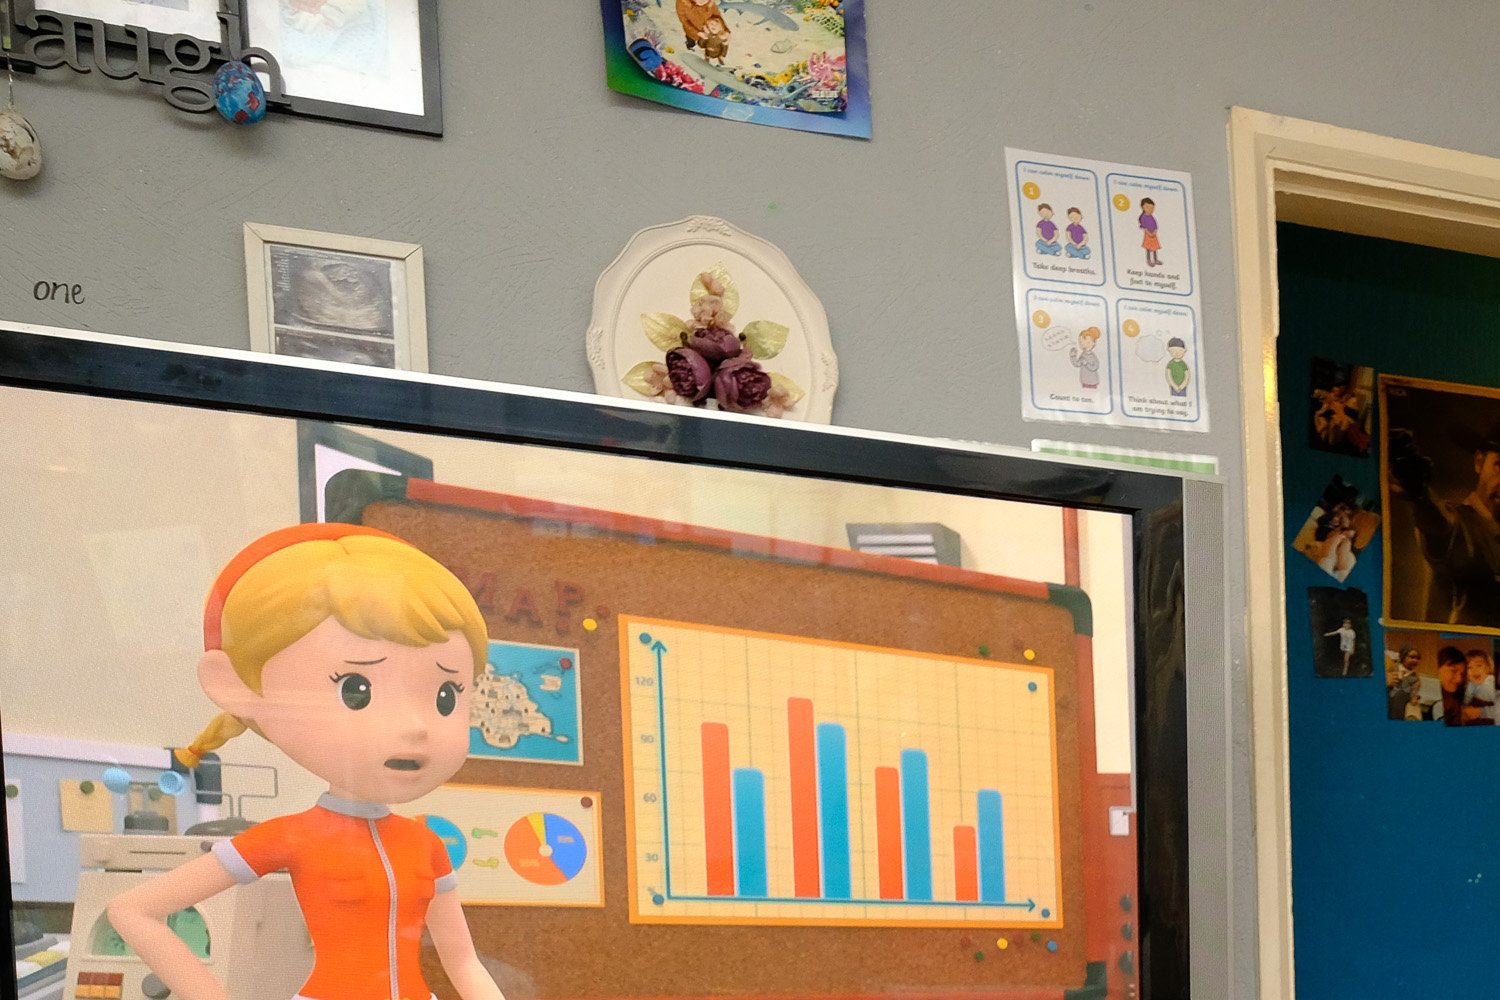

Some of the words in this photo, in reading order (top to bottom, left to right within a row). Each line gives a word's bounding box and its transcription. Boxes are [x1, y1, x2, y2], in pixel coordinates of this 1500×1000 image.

[0, 11, 292, 113] augh
[1051, 264, 1066, 273] deep
[1145, 270, 1165, 278] hands
[32, 277, 86, 306] one
[1050, 393, 1070, 401] Count
[1145, 407, 1165, 415] trying
[635, 676, 654, 687] 120
[640, 734, 654, 744] 90
[643, 792, 657, 803] 60
[645, 852, 659, 863] 30
